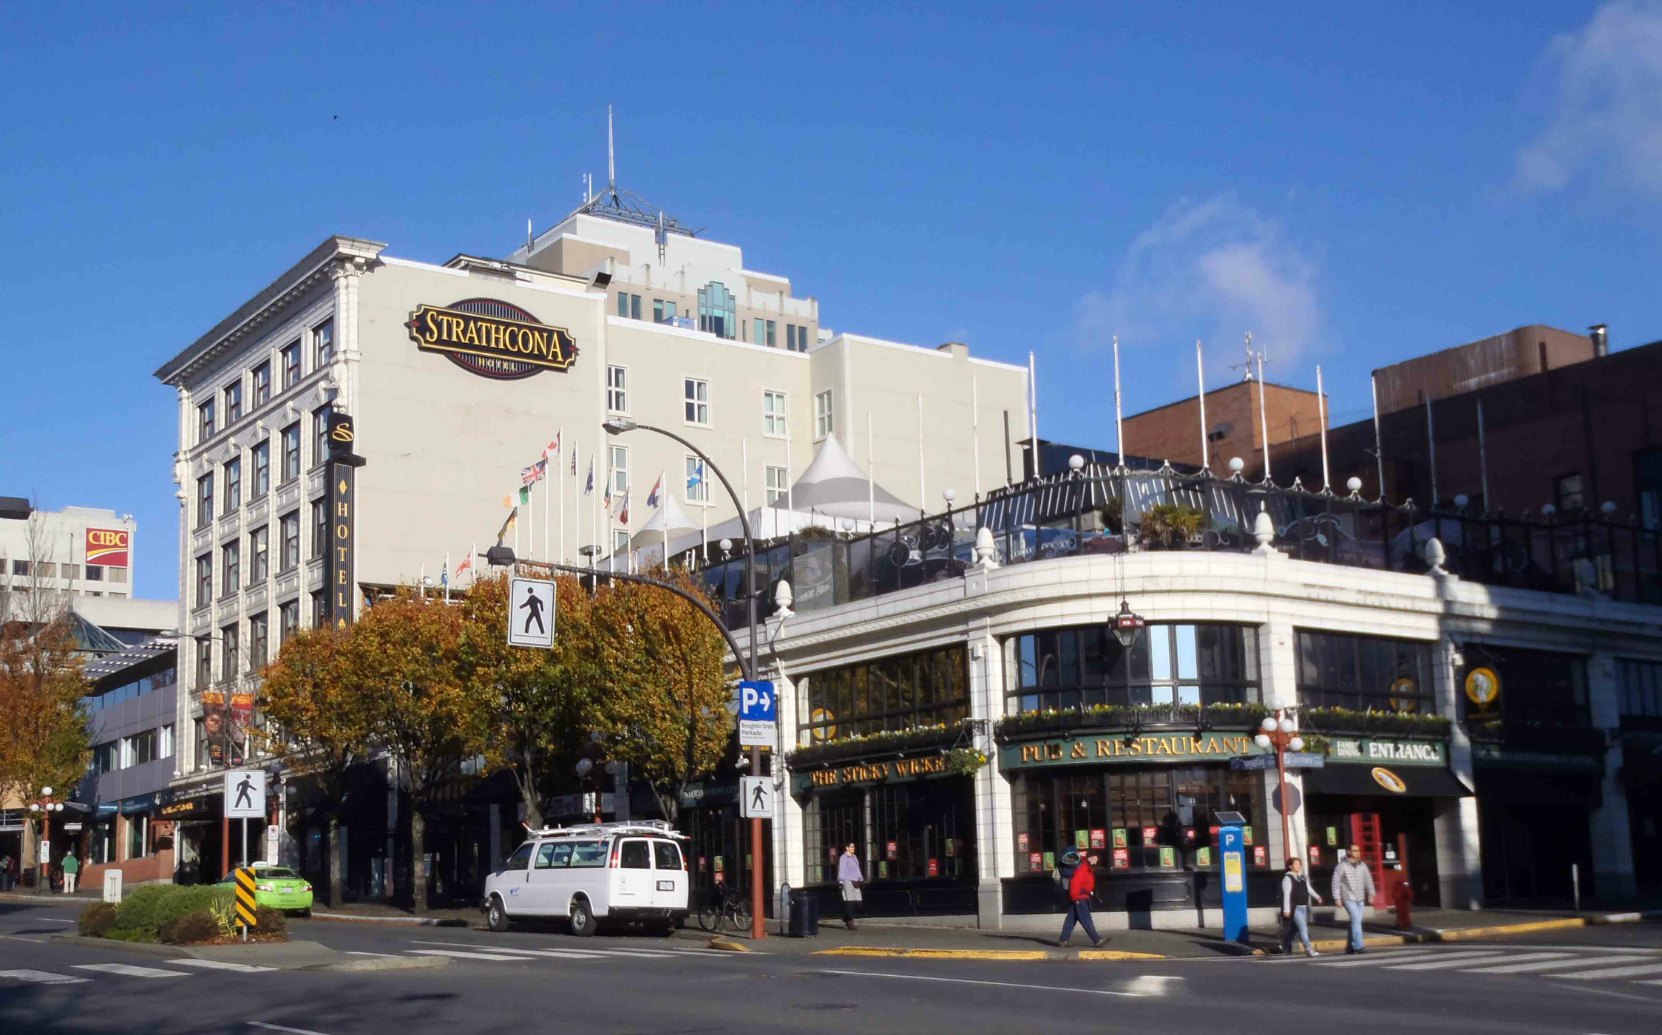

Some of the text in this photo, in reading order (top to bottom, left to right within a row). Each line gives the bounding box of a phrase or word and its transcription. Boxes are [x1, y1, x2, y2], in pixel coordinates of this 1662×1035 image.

[426, 311, 564, 362] STRATHCONA
[479, 357, 517, 372] HOTEL
[332, 422, 353, 442] S
[88, 530, 127, 547] CIBC
[337, 502, 348, 608] HOTEL
[742, 687, 758, 714] P
[1071, 742, 1088, 758] &
[1095, 736, 1250, 757] RESTAURANT
[842, 762, 889, 783] STICKY
[894, 757, 946, 777] WICKE
[1225, 834, 1234, 846] P
